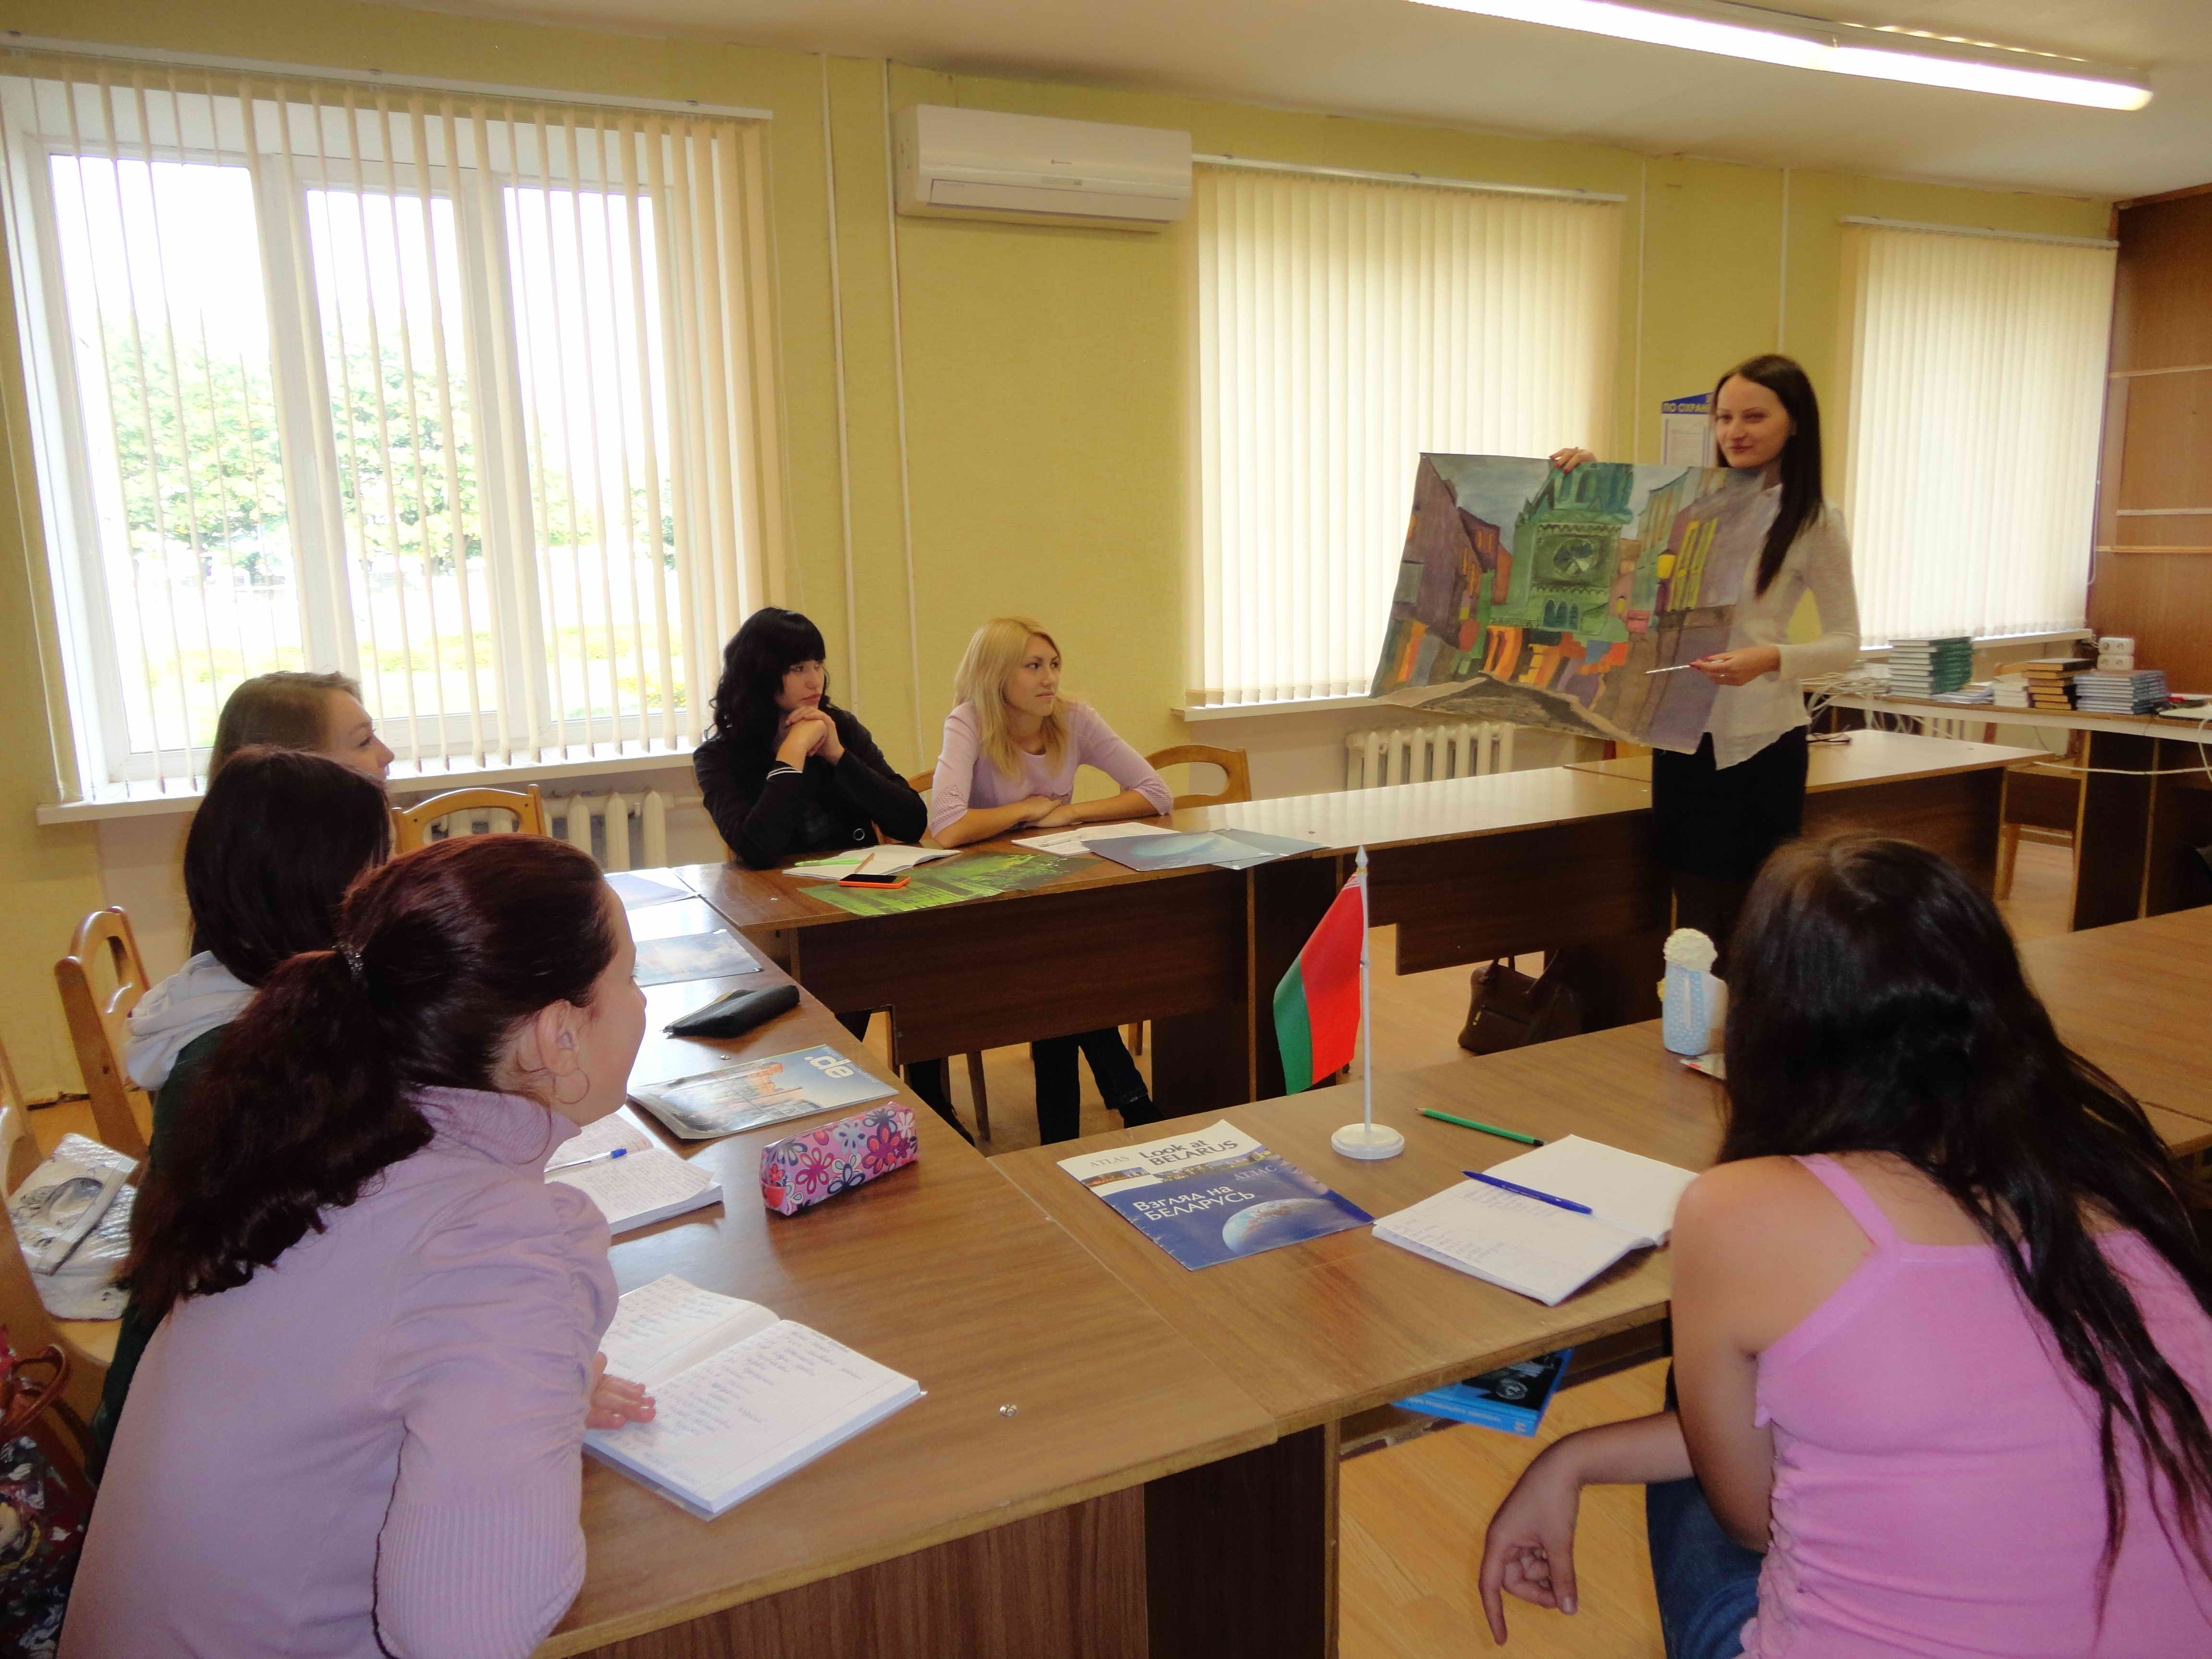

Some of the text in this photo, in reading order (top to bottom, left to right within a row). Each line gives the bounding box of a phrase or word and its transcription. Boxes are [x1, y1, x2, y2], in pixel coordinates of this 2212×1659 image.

[1090, 1155, 1130, 1167] ATLAS
[1138, 1144, 1188, 1158] Look
[1148, 1141, 1238, 1166] BELARUS
[1234, 1165, 1277, 1180] АТЛАС
[1132, 1186, 1234, 1211] Взгляд на
[1144, 1192, 1255, 1221] БЕЛАРУСЬ
